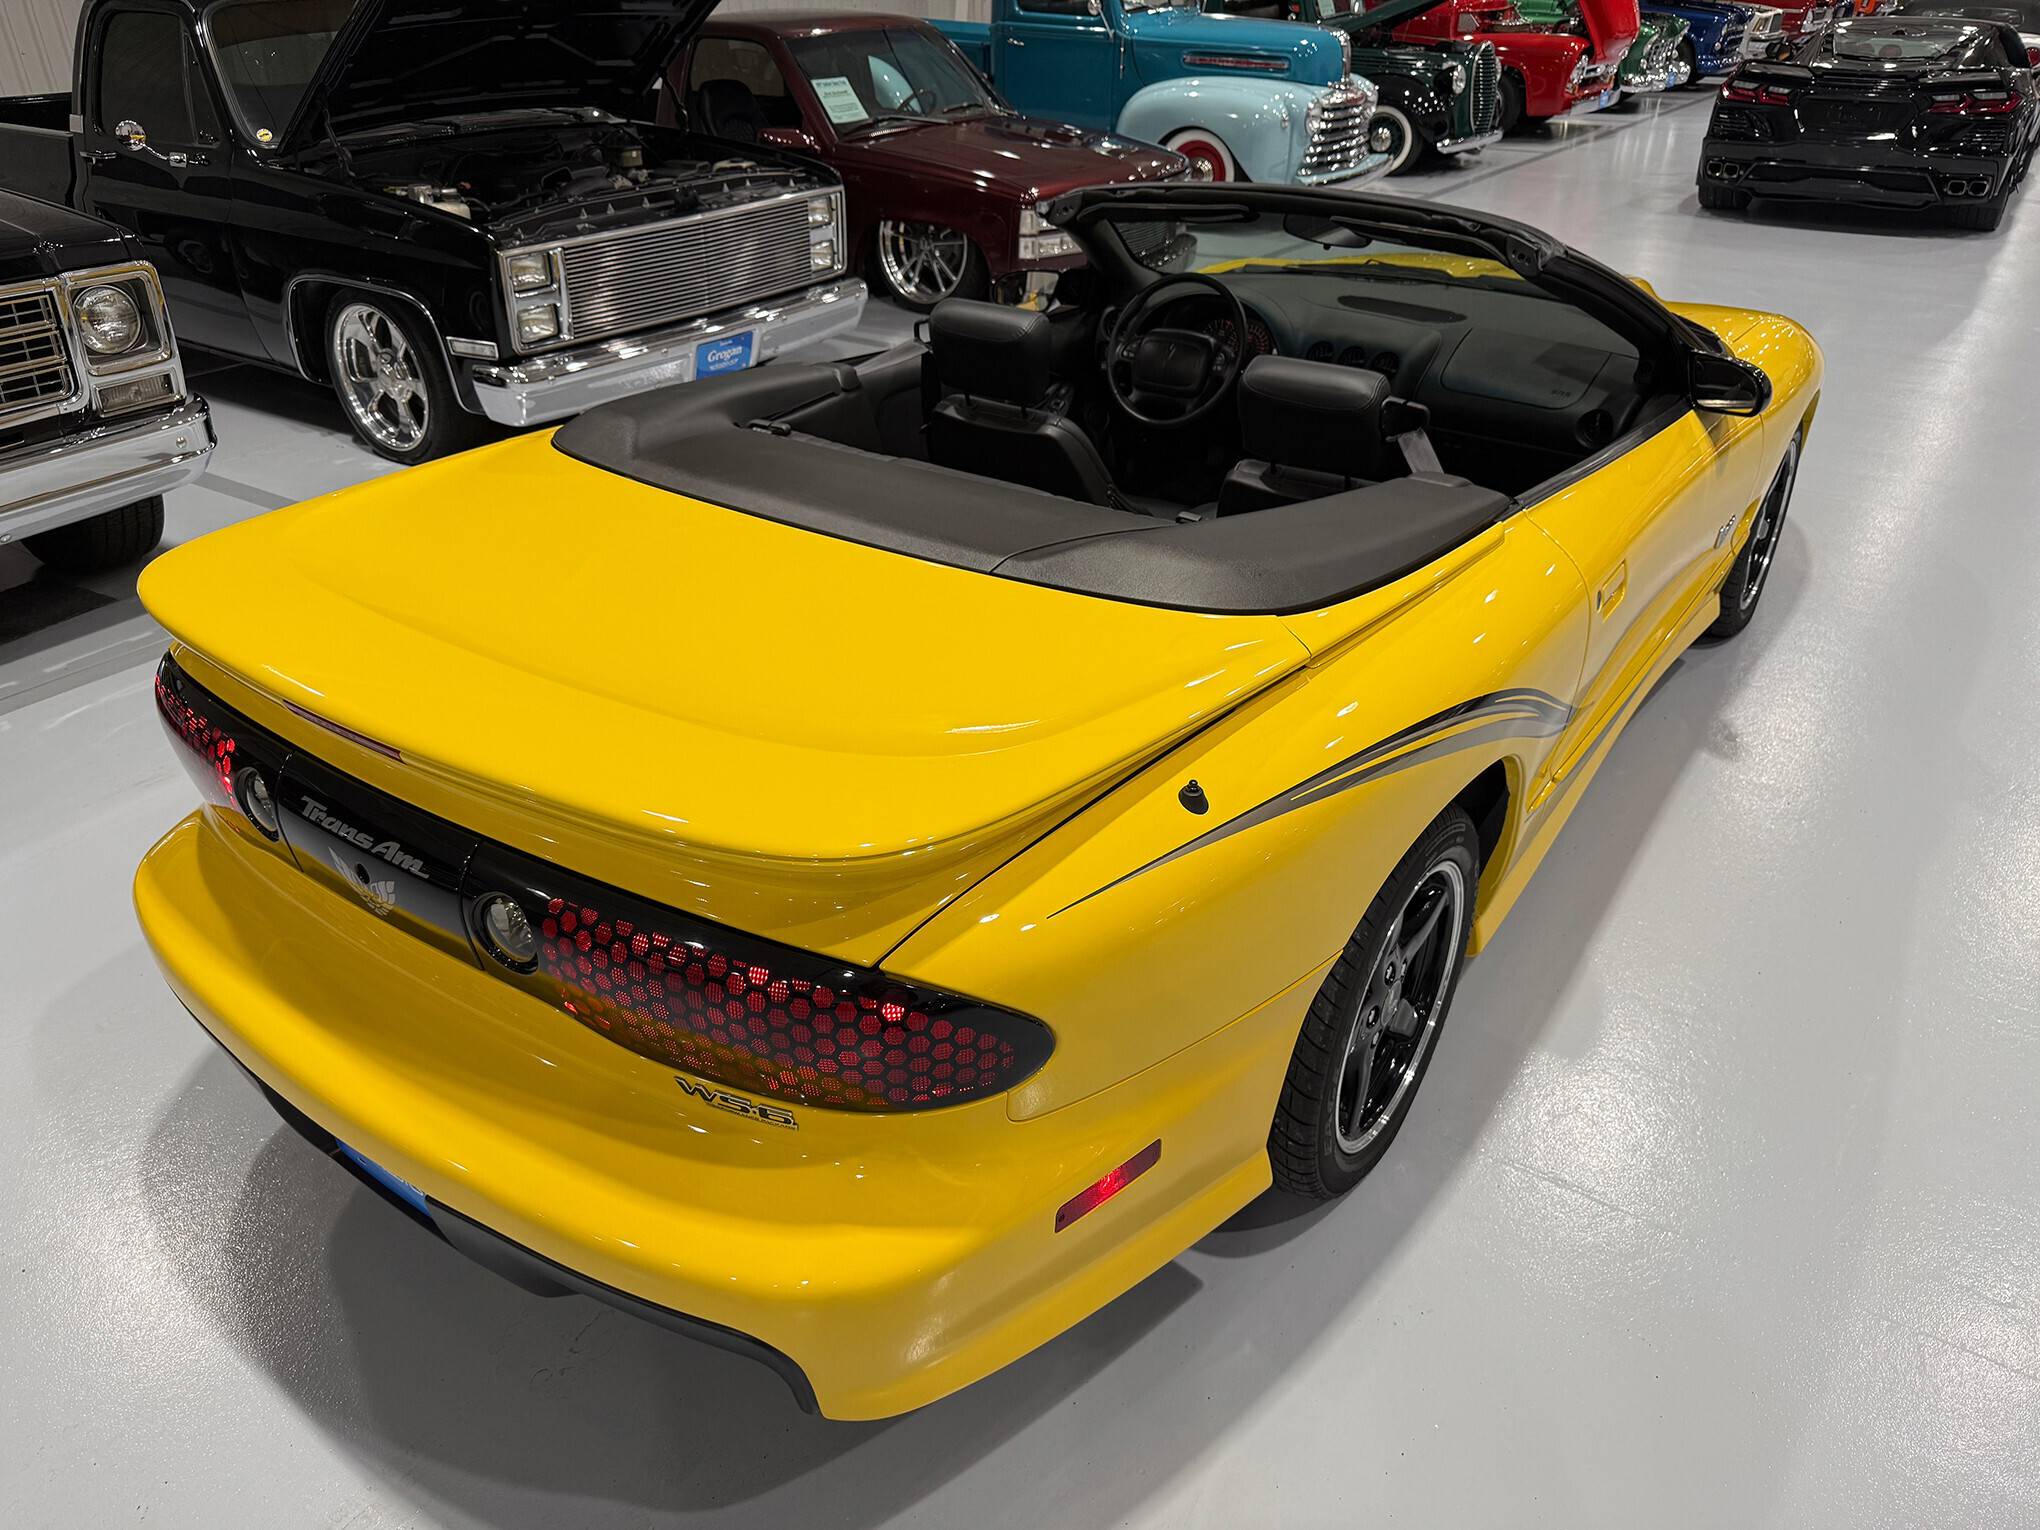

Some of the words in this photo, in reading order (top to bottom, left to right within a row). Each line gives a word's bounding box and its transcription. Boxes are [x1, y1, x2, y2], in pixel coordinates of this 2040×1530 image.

[707, 345, 742, 363] Grogan
[301, 795, 374, 849] Trans
[371, 841, 430, 879] Am
